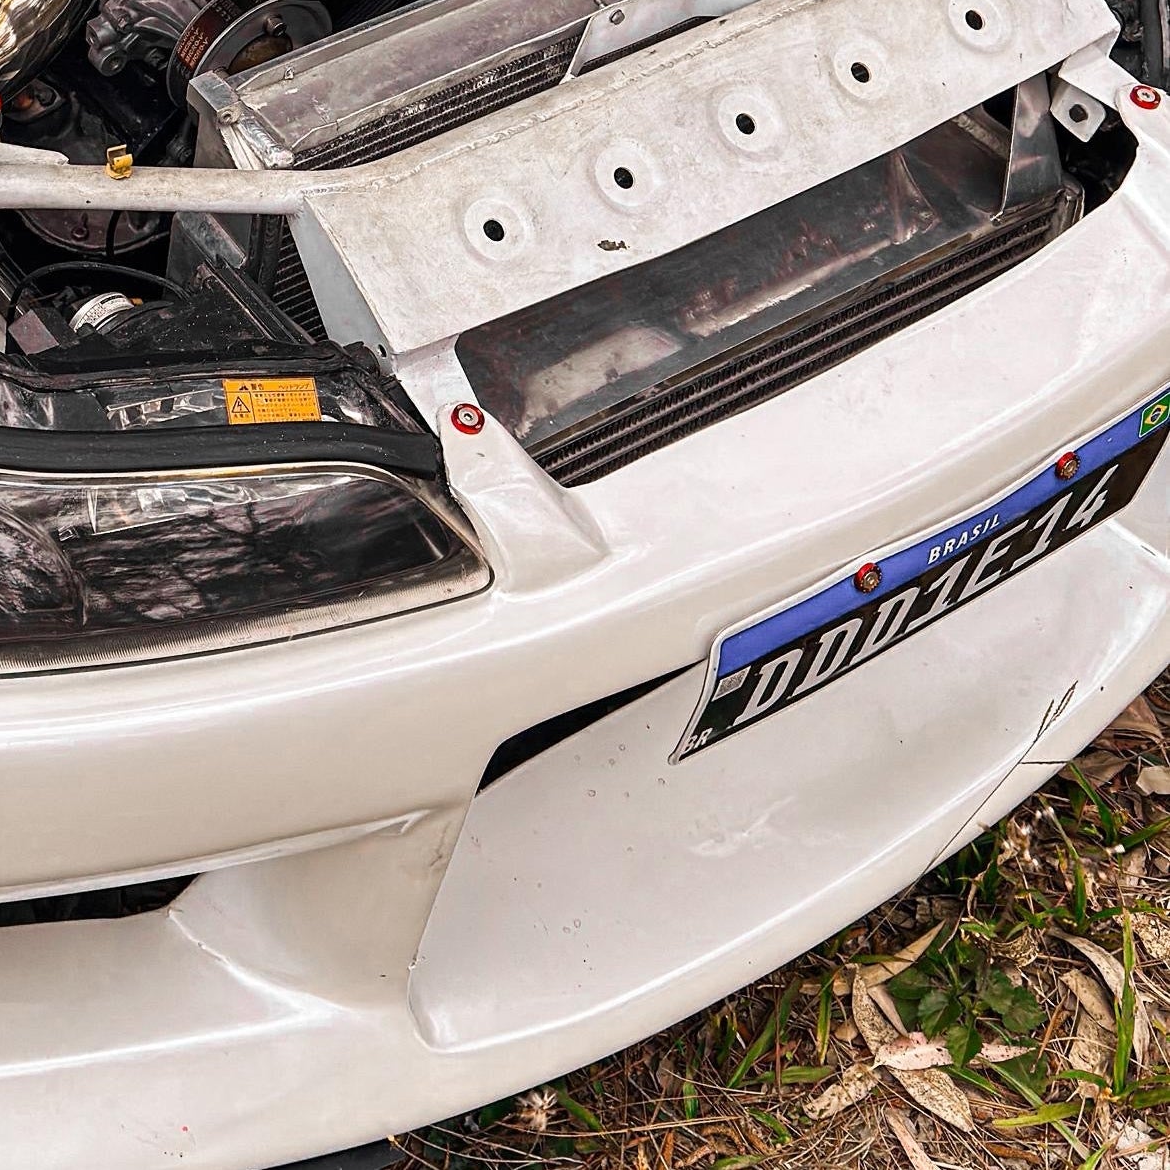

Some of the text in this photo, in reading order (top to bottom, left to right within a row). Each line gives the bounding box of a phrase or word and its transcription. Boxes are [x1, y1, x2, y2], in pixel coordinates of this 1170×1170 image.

[927, 513, 1000, 564] BRASIL
[728, 464, 1119, 729] DDD1E14
[684, 728, 713, 755] BR
